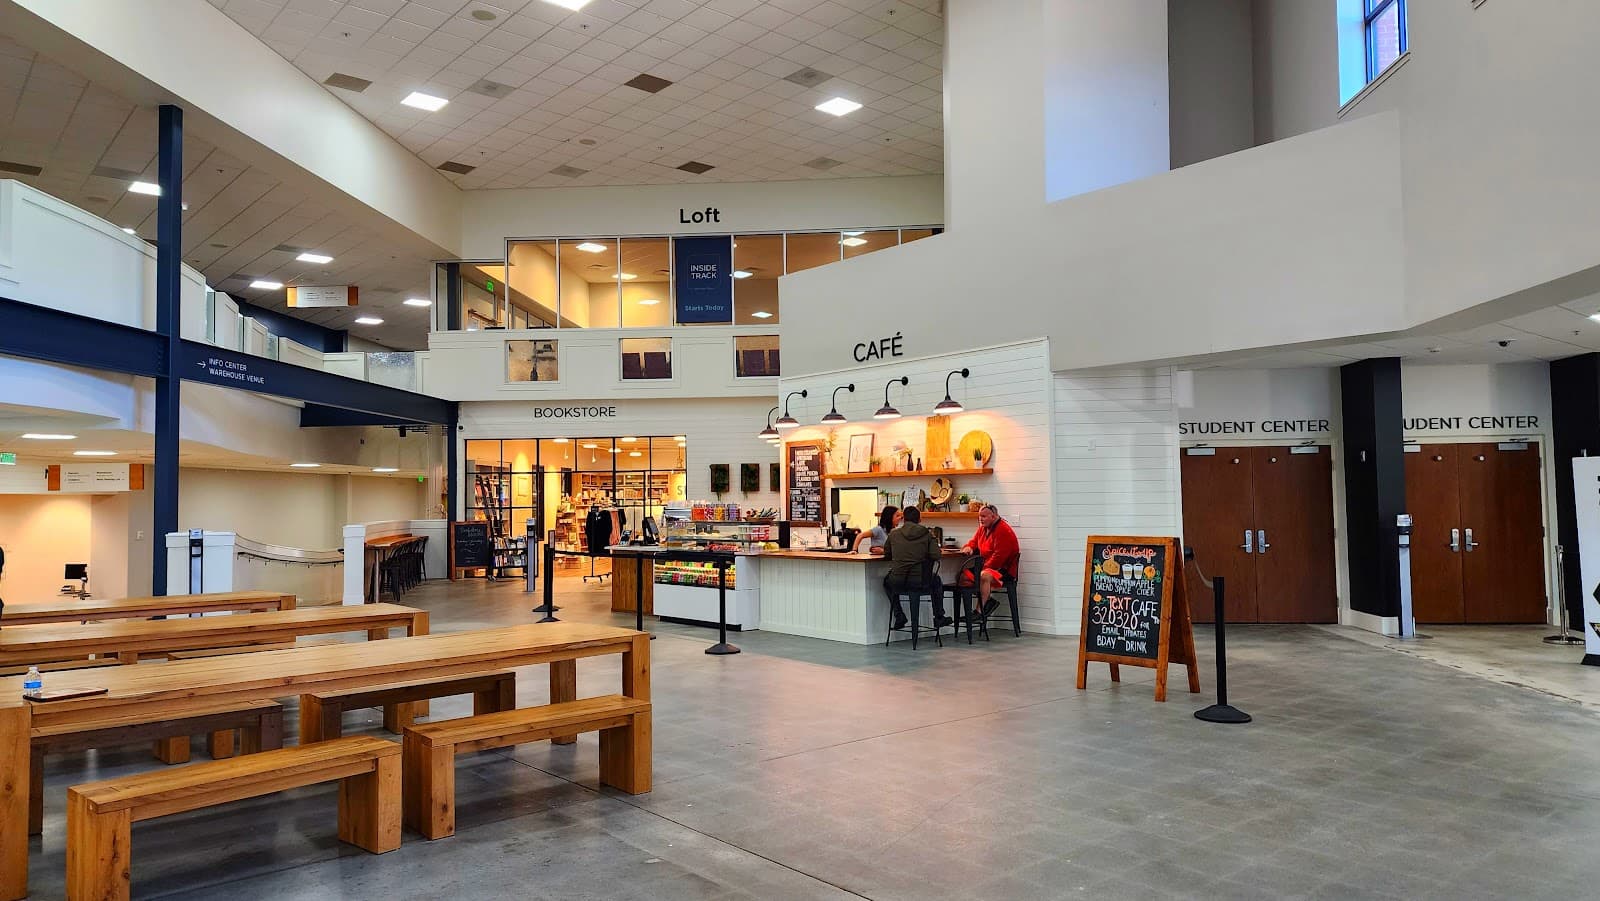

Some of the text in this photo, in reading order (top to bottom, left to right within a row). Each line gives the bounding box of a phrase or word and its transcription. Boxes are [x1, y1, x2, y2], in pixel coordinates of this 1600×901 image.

[680, 207, 720, 224] Loft
[690, 264, 717, 272] INSIDE
[705, 304, 725, 312] Today
[853, 331, 904, 362] CAFÉ
[208, 358, 247, 371] INFO CENTER
[208, 368, 265, 384] WAREHOUSE VENUE
[534, 406, 617, 418] BOOKSTORE
[1179, 419, 1330, 435] STUDENT CENTER
[1402, 415, 1539, 430] UDENT CENTER
[1096, 582, 1114, 591] BREAD
[1091, 606, 1138, 630] 320320
[1101, 625, 1147, 639] EMAIL UPDATES
[1096, 635, 1116, 649] BDAY
[1125, 640, 1147, 654] DRINK
